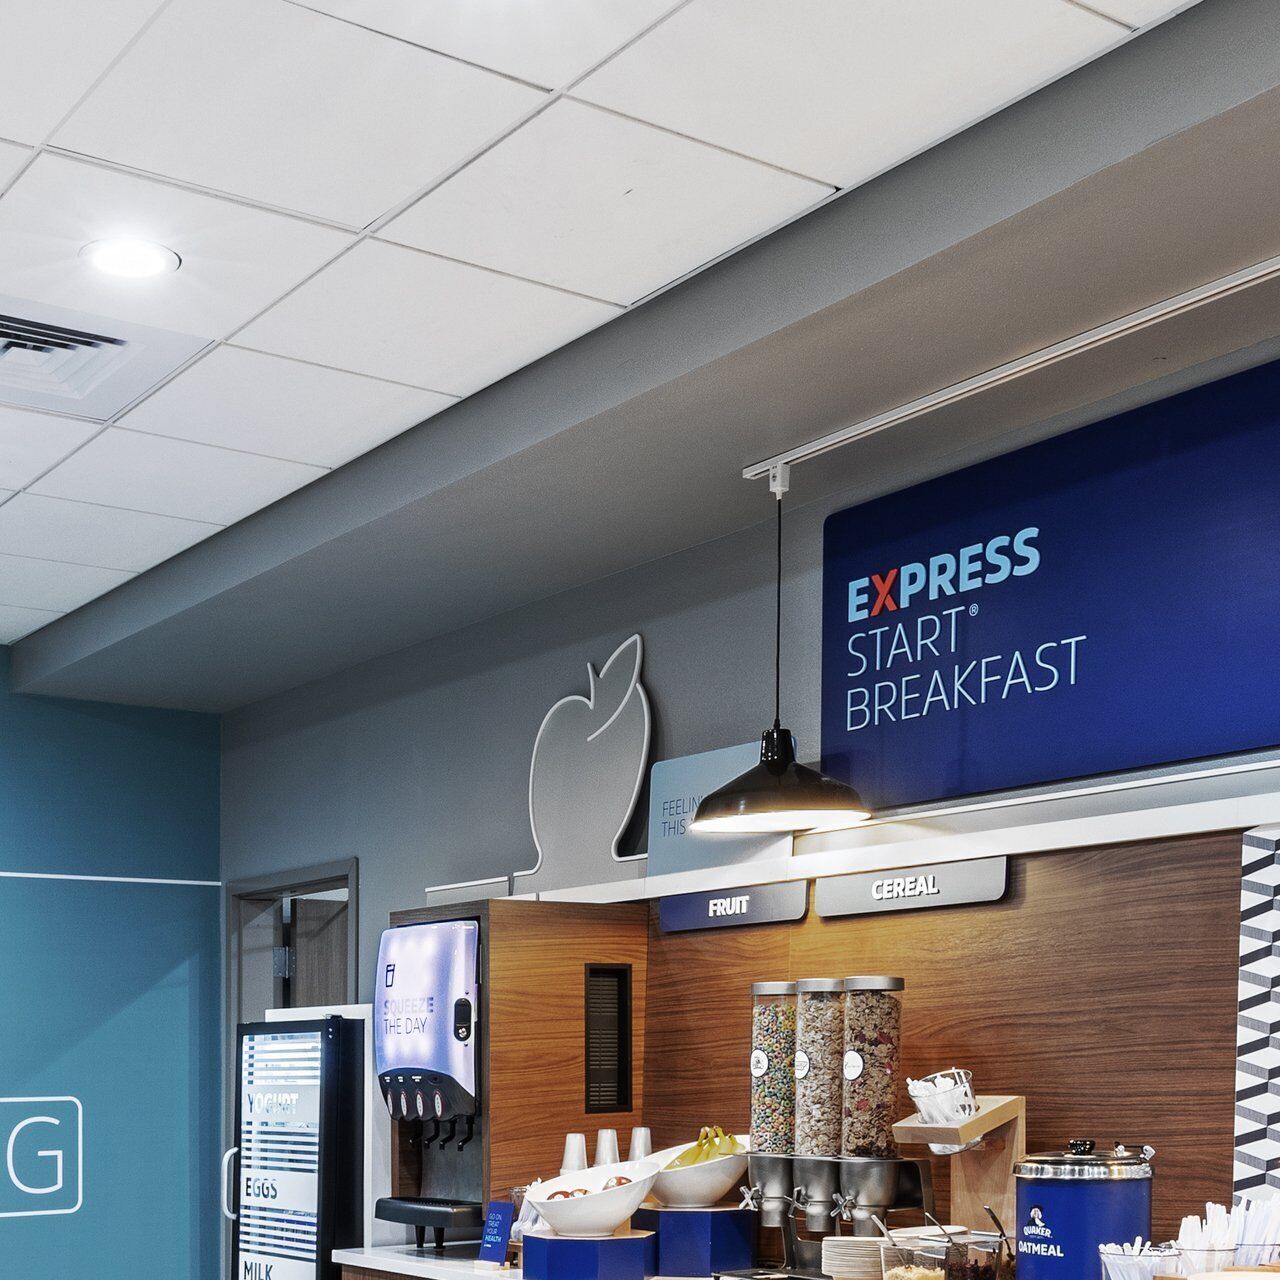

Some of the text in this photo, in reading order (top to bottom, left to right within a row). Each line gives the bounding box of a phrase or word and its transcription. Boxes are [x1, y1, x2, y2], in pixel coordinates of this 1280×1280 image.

[847, 525, 1041, 623] EXPRESS
[846, 635, 1087, 732] BREAKFAST
[661, 818, 687, 837] THIS
[872, 875, 939, 901] CEREAL
[708, 895, 750, 917] FRUIT
[384, 997, 434, 1016] SQUEEZE
[384, 1017, 428, 1035] THE DAY
[247, 1092, 298, 1114] YOGURT
[245, 1177, 278, 1200] EGGS
[1023, 1225, 1052, 1238] QUAKER
[1018, 1241, 1064, 1257] OATMEAL
